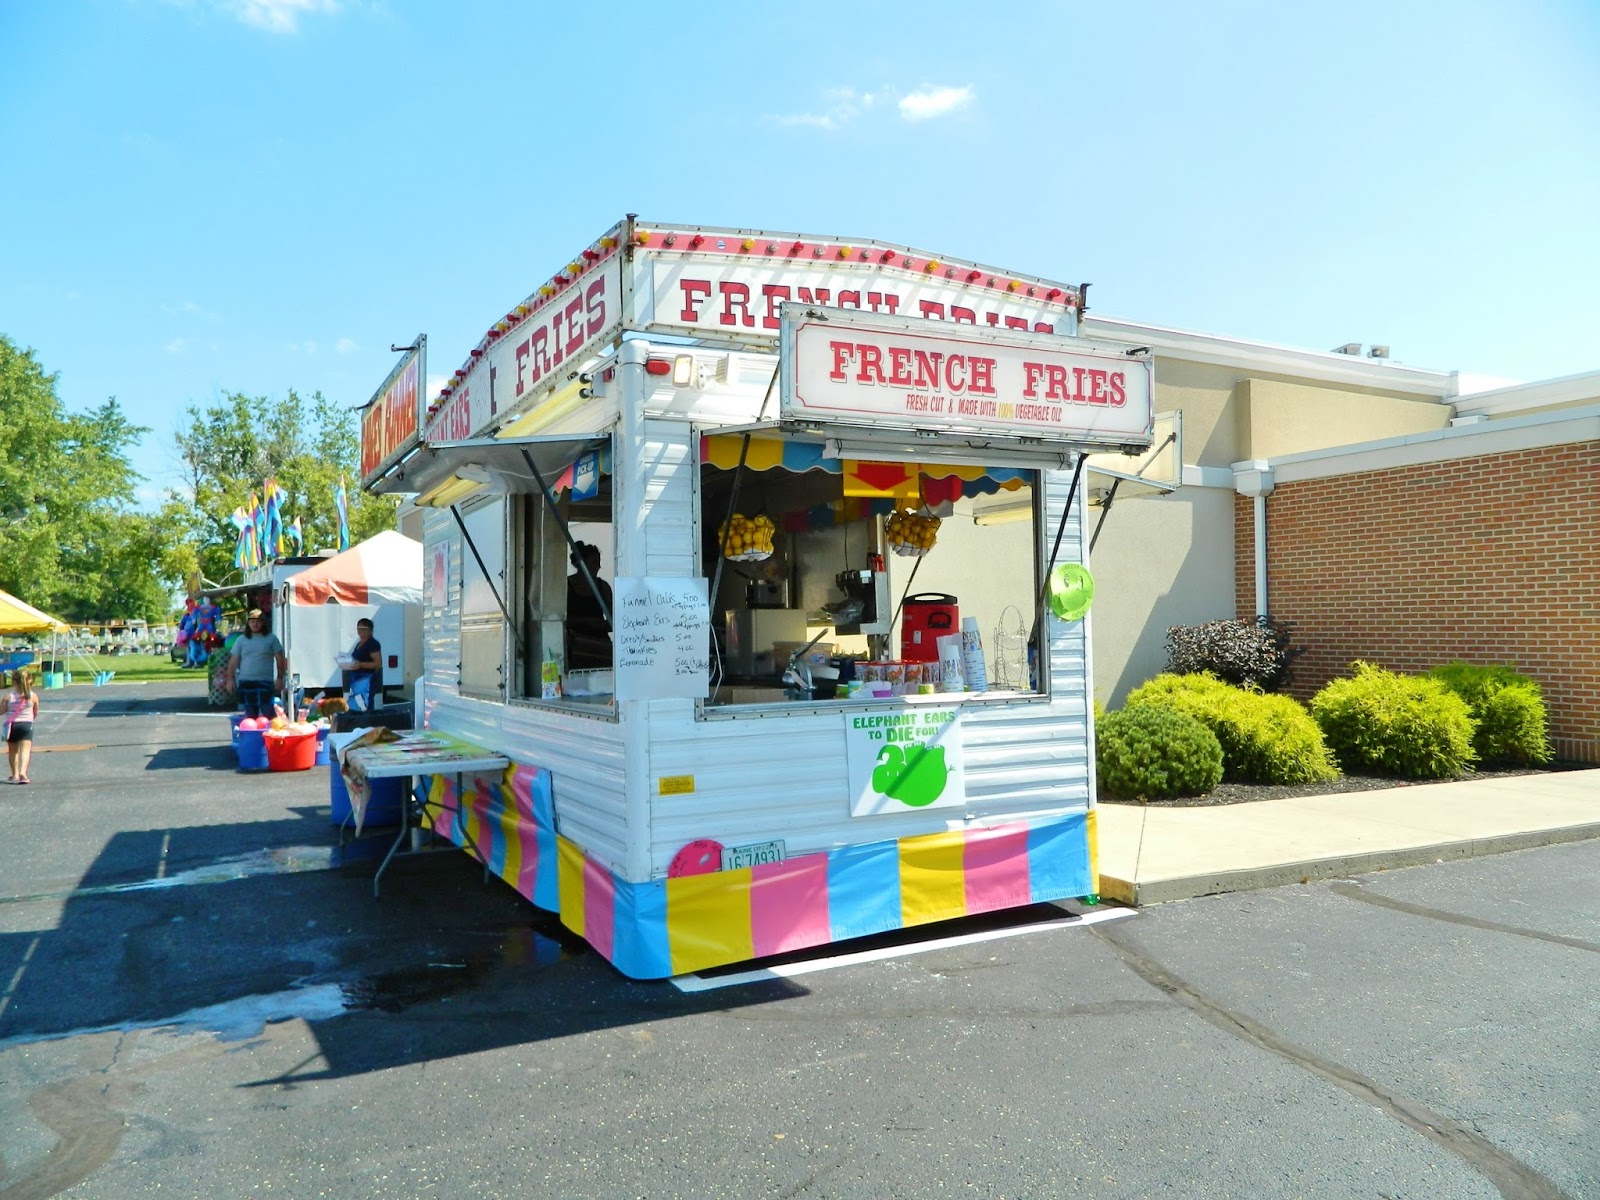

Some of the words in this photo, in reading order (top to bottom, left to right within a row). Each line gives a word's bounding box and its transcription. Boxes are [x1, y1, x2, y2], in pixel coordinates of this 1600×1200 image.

[516, 274, 606, 397] FRIES
[829, 340, 997, 396] FRENCH
[1023, 361, 1128, 408] FRIES
[906, 394, 928, 411] FRESH
[930, 396, 945, 413] CUT
[958, 399, 978, 415] MADE
[979, 401, 996, 417] WITH
[997, 403, 1014, 420] 100%
[1015, 403, 1050, 422] VEGETABLE
[1050, 407, 1063, 422] OIL
[853, 713, 917, 729] ELEPHANT
[924, 711, 955, 724] EARS
[868, 730, 882, 740] TO
[886, 726, 914, 742] DIE
[915, 726, 939, 737] FOR!
